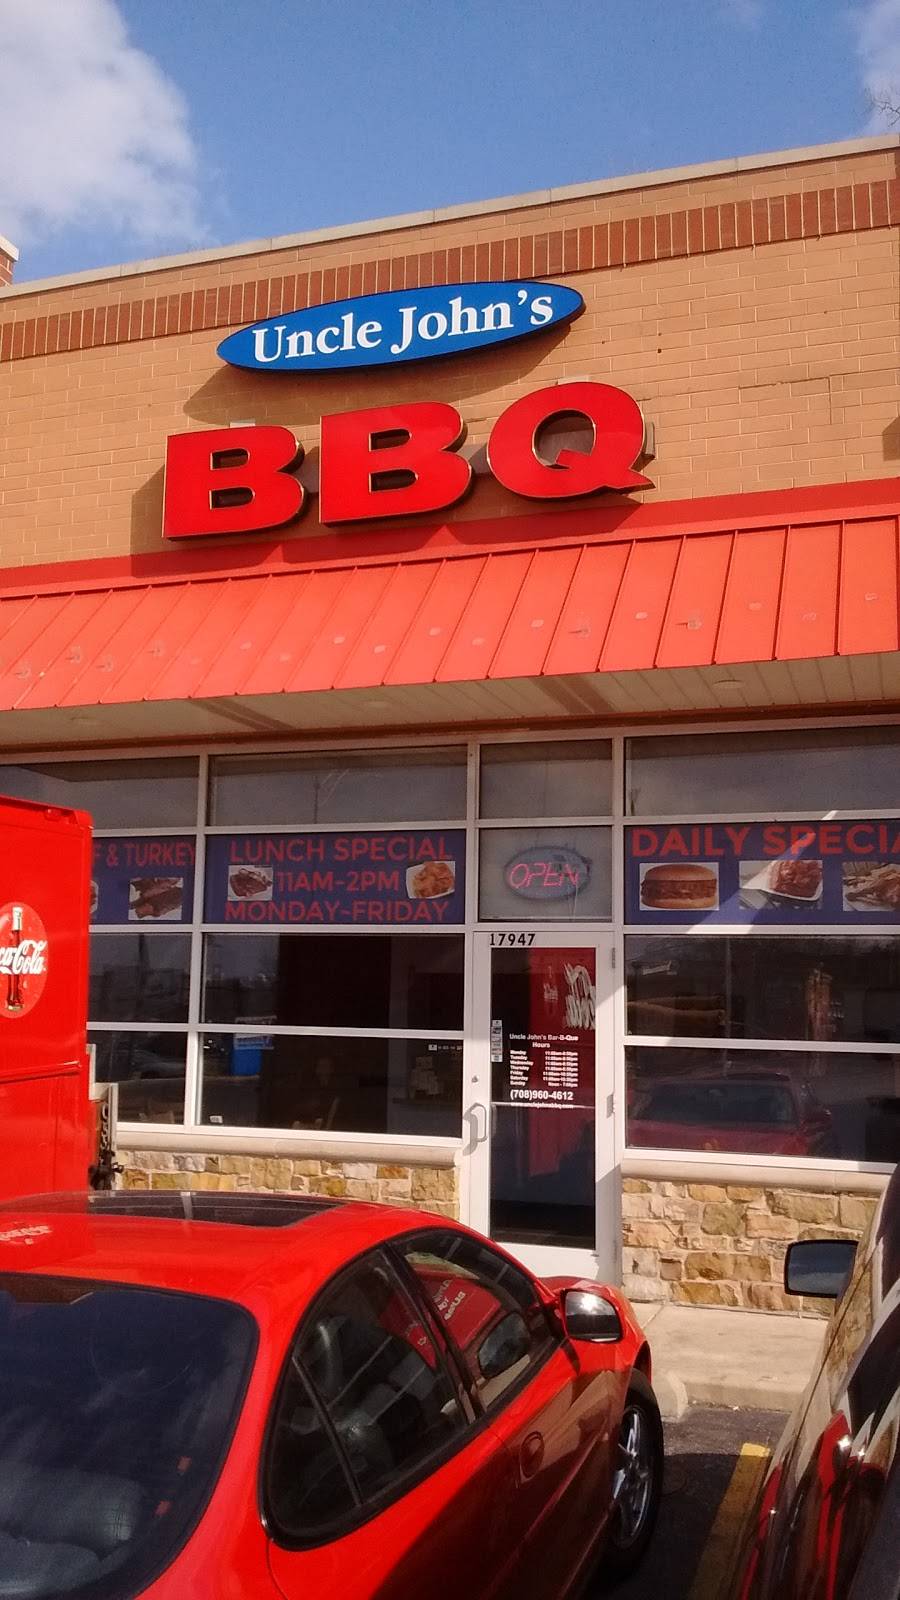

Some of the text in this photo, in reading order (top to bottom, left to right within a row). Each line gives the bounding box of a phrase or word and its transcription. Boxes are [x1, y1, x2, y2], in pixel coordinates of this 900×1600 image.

[251, 289, 554, 364] Uncle John's
[161, 381, 656, 540] BBQ
[230, 835, 453, 864] LUNCH SPECIAL
[631, 825, 751, 857] DAILY
[106, 842, 119, 869] &
[277, 870, 400, 893] 11AM-2PM
[508, 861, 581, 889] OPEN
[224, 899, 450, 923] MONDAY-FRIDAY
[490, 933, 536, 946] 17947
[527, 1033, 547, 1041] John's
[548, 1034, 579, 1042] Bar-B-Que
[510, 1089, 574, 1100] (708)960-4612
